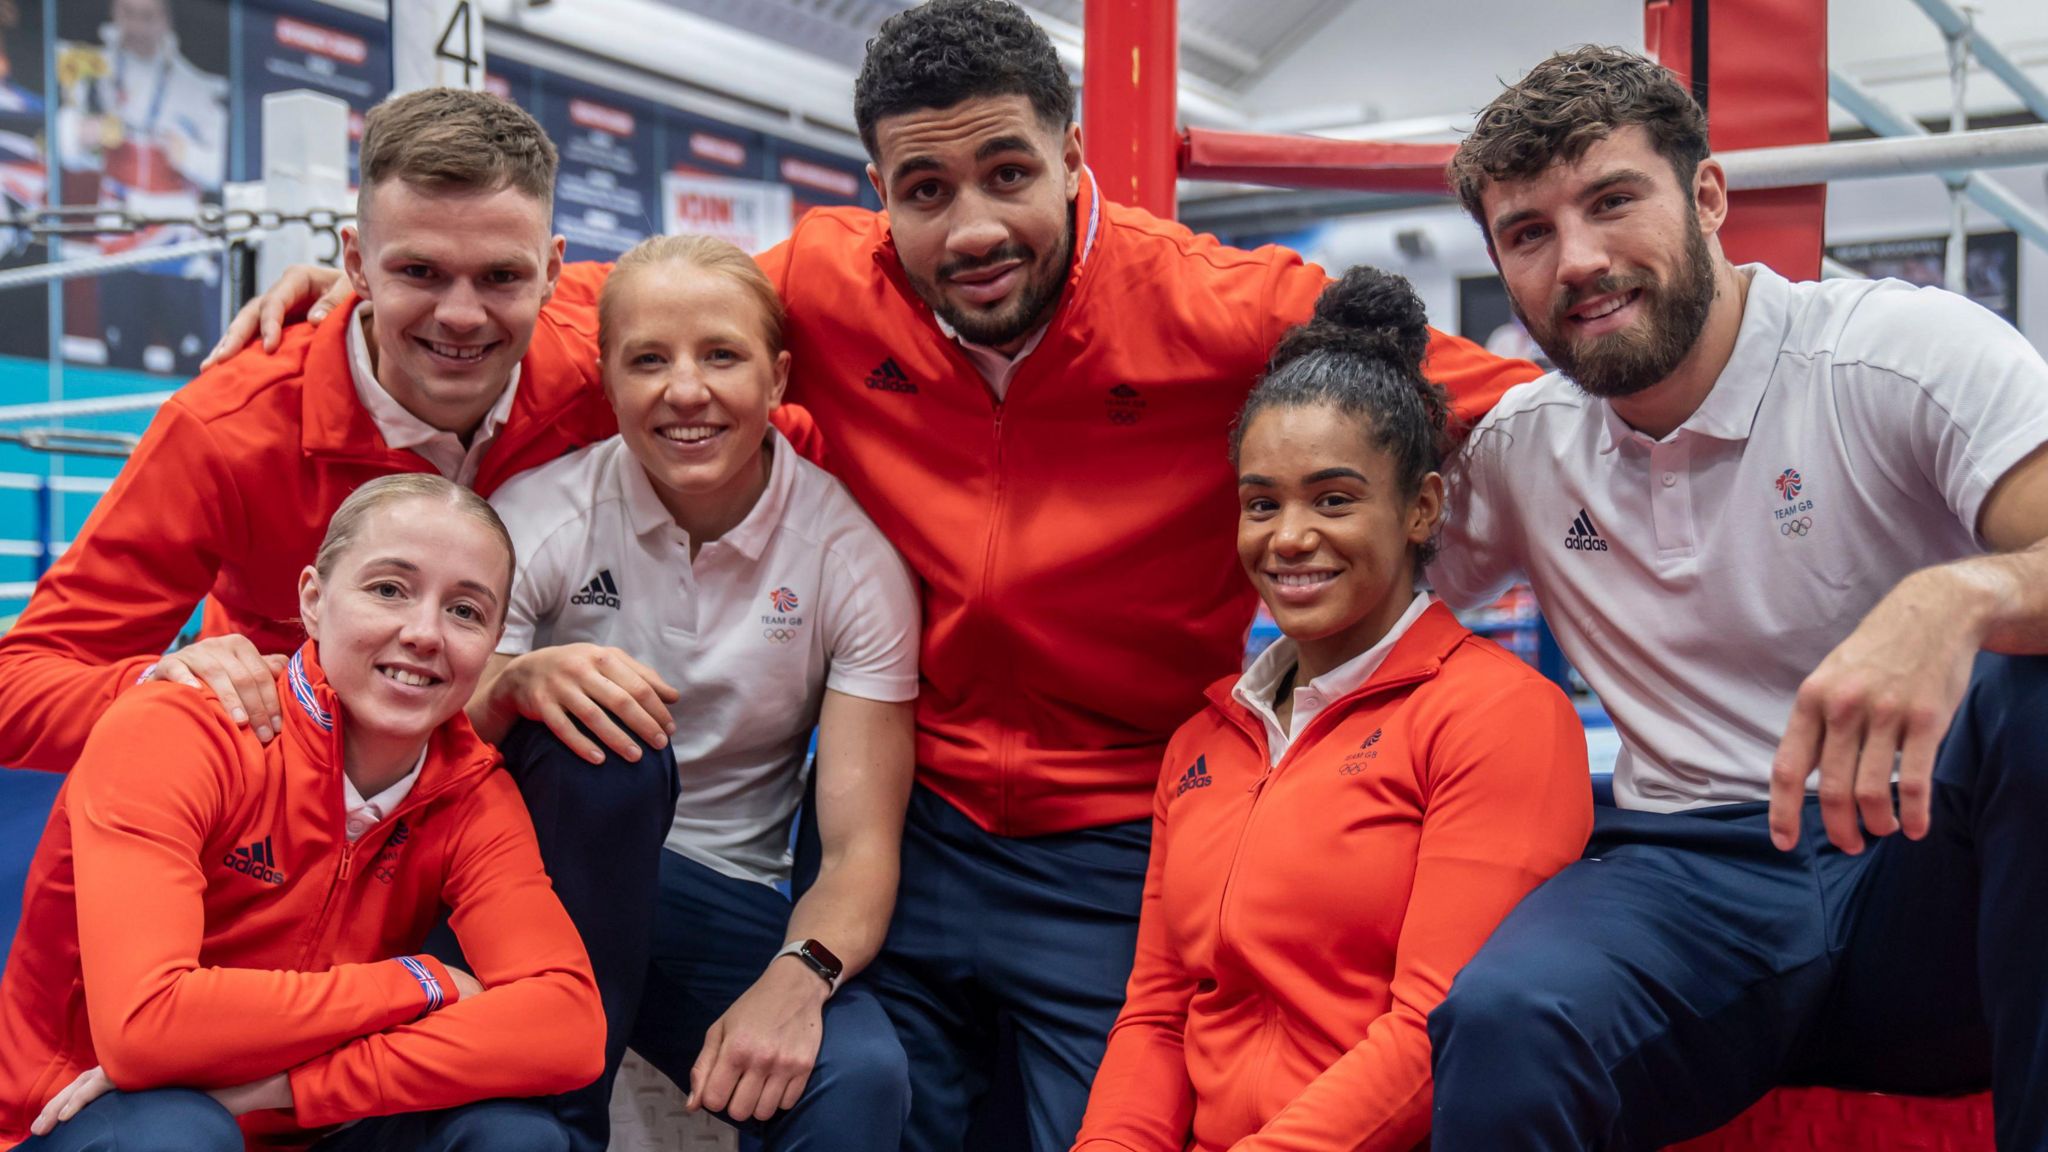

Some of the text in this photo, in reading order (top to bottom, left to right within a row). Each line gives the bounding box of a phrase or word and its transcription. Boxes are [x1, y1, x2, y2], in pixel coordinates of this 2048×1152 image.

[435, 0, 479, 85] 4
[864, 376, 919, 395] adidas
[1774, 500, 1814, 520] TEAM GB
[1564, 535, 1608, 552] adidas
[570, 591, 621, 611] adidas
[761, 615, 802, 626] TEAM GB
[1364, 750, 1378, 759] GB
[223, 853, 284, 885] adidas
